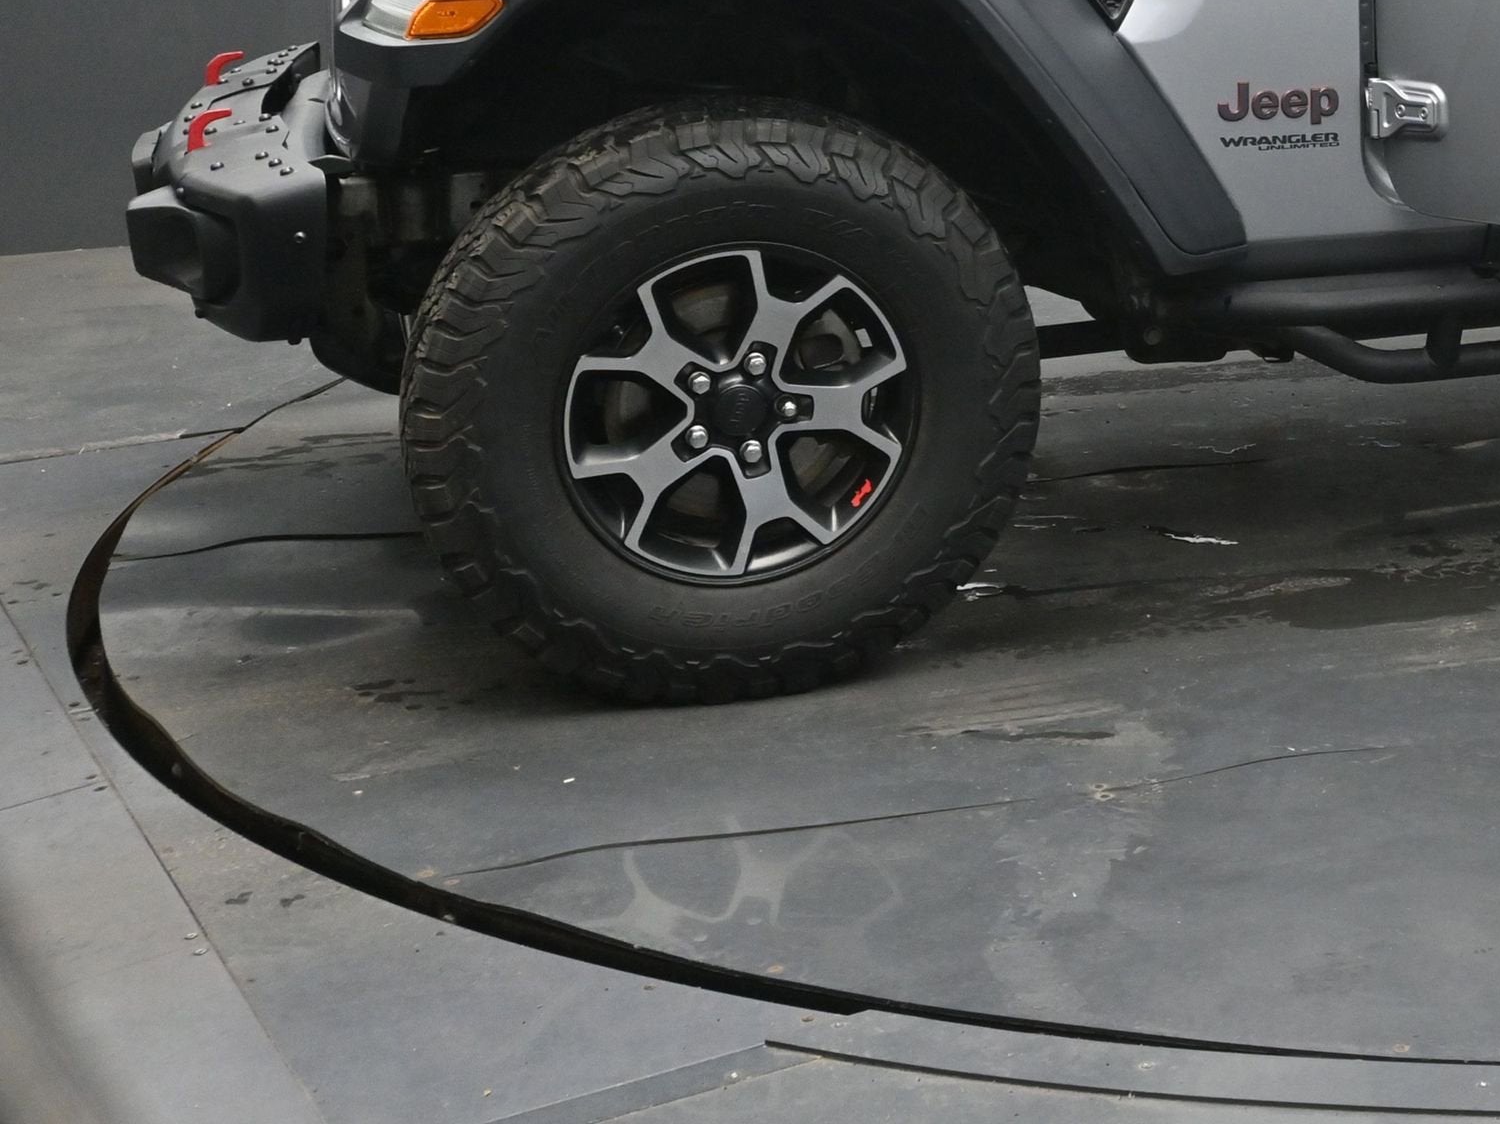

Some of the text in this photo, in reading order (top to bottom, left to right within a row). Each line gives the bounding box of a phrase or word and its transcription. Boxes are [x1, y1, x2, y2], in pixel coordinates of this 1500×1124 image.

[1217, 82, 1339, 125] Jeep
[1220, 133, 1340, 148] WRANGLER
[1258, 142, 1340, 151] UNLIMITED
